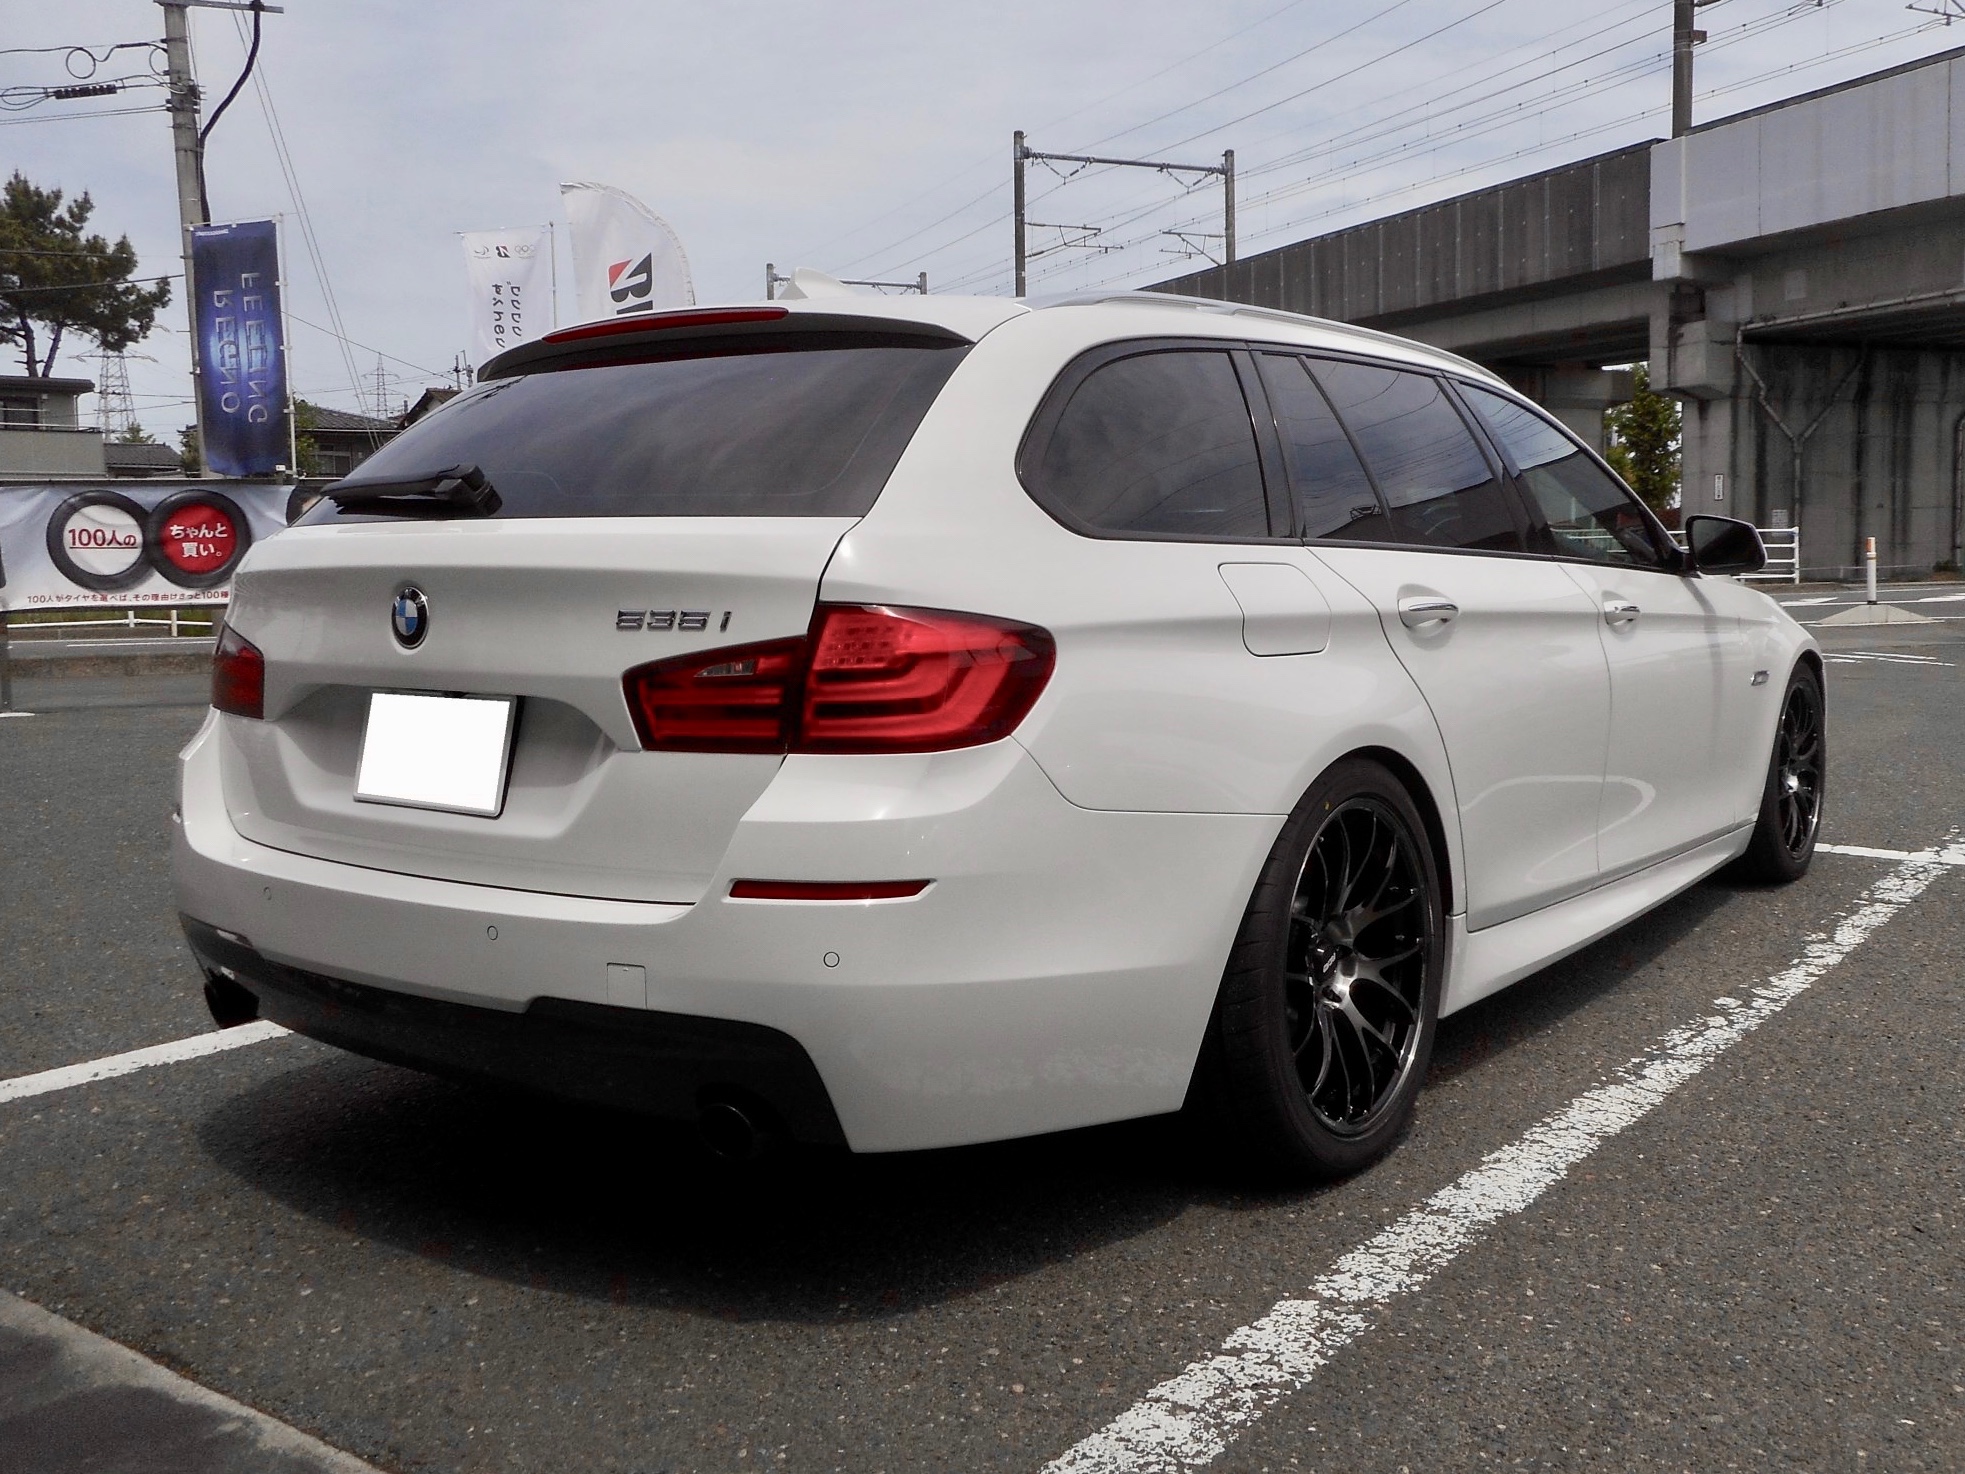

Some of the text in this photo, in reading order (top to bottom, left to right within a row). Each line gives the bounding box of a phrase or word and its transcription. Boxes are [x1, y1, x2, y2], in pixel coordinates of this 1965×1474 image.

[68, 528, 137, 546] 100人の
[169, 523, 228, 539] ちゃんと
